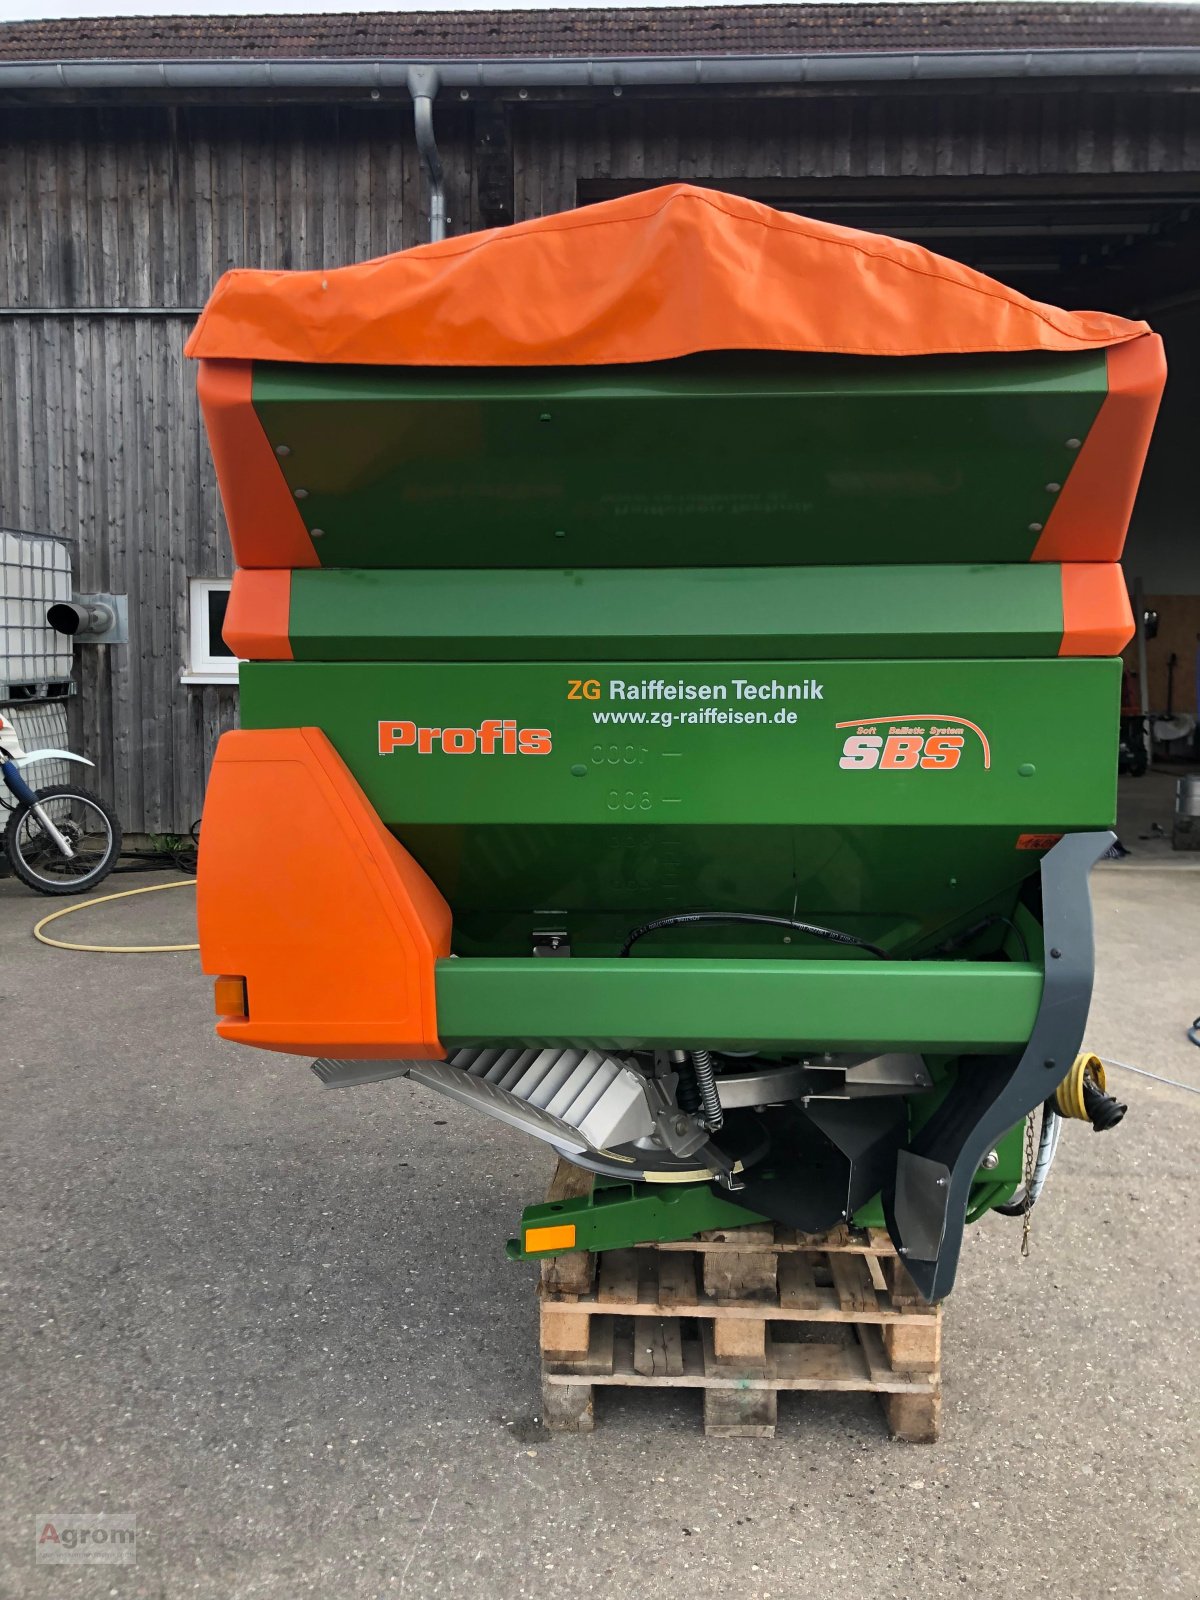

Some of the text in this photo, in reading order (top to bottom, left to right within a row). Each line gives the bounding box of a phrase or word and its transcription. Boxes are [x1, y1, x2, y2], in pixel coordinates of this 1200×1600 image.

[567, 680, 824, 700] ZG Raiffeisen Technik
[592, 708, 798, 728] www.zg-raiffeisen.de
[378, 719, 552, 755] Profis
[856, 727, 877, 735] Soft
[929, 727, 964, 736] System
[839, 735, 965, 769] SBS
